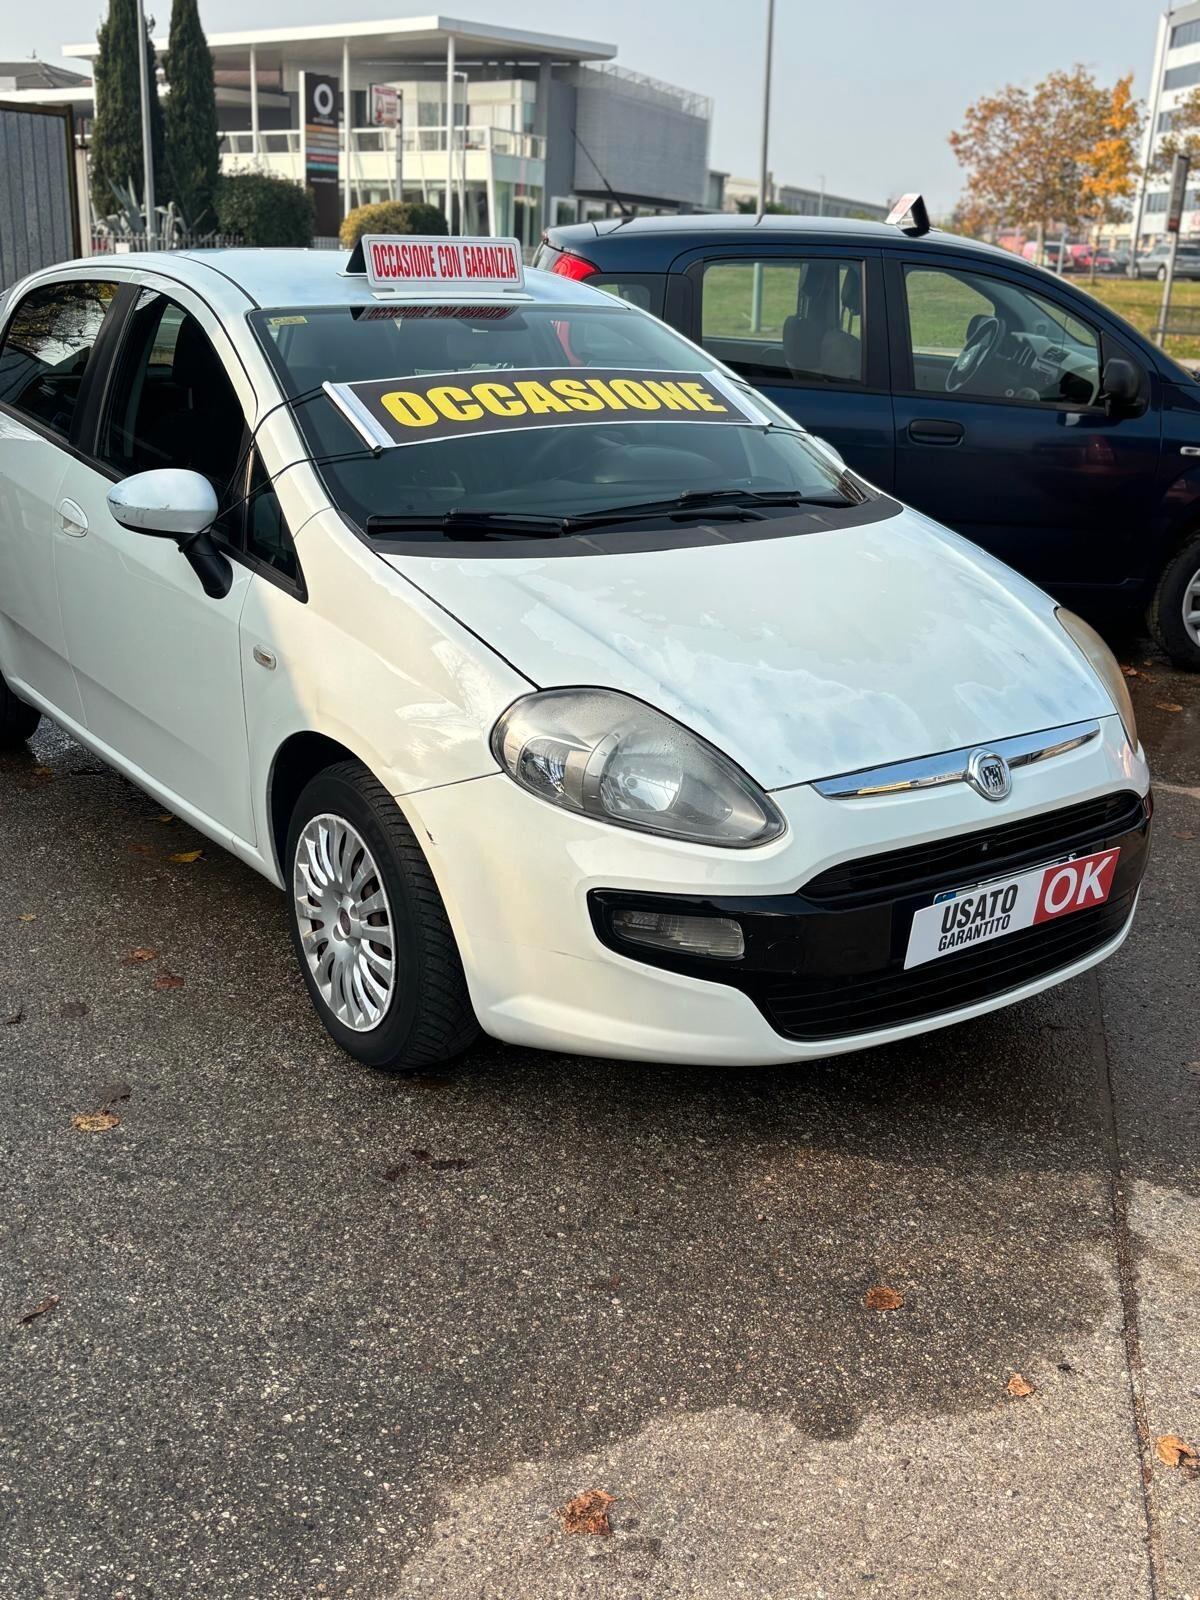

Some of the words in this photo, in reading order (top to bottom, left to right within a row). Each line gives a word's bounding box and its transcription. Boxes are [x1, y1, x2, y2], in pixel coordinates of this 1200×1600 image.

[373, 244, 436, 279] OCCASIONE
[438, 245, 462, 279] CON
[465, 246, 517, 279] GARANZIA
[380, 379, 728, 427] OCCASIONE
[941, 884, 1019, 934] USATO
[1043, 856, 1113, 914] OK
[938, 914, 1011, 952] GARANTITO
